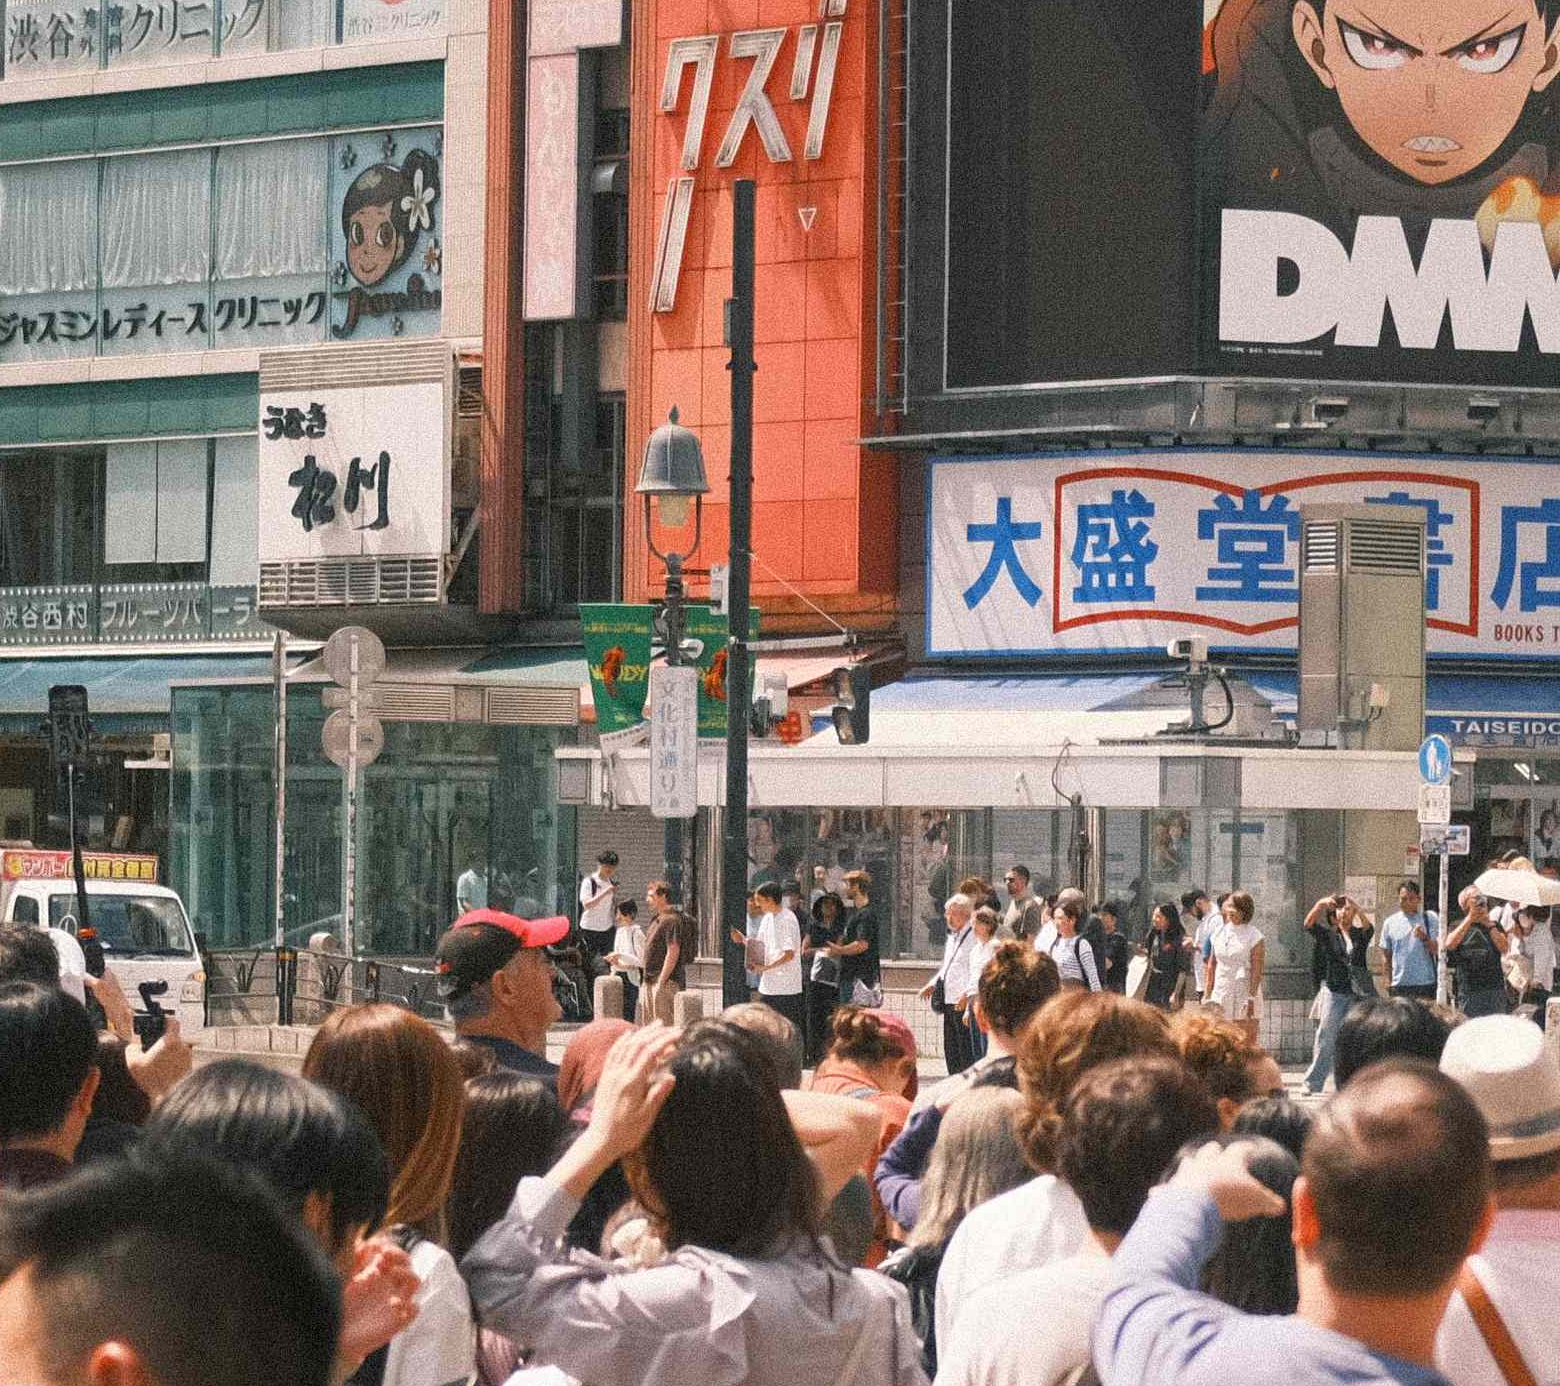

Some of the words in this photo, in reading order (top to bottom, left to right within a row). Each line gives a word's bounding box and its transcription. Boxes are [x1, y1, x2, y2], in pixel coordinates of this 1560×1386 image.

[8, 13, 75, 64] 渋谷
[2, 600, 88, 629] 渋谷西村
[1494, 623, 1545, 643] BOOKS
